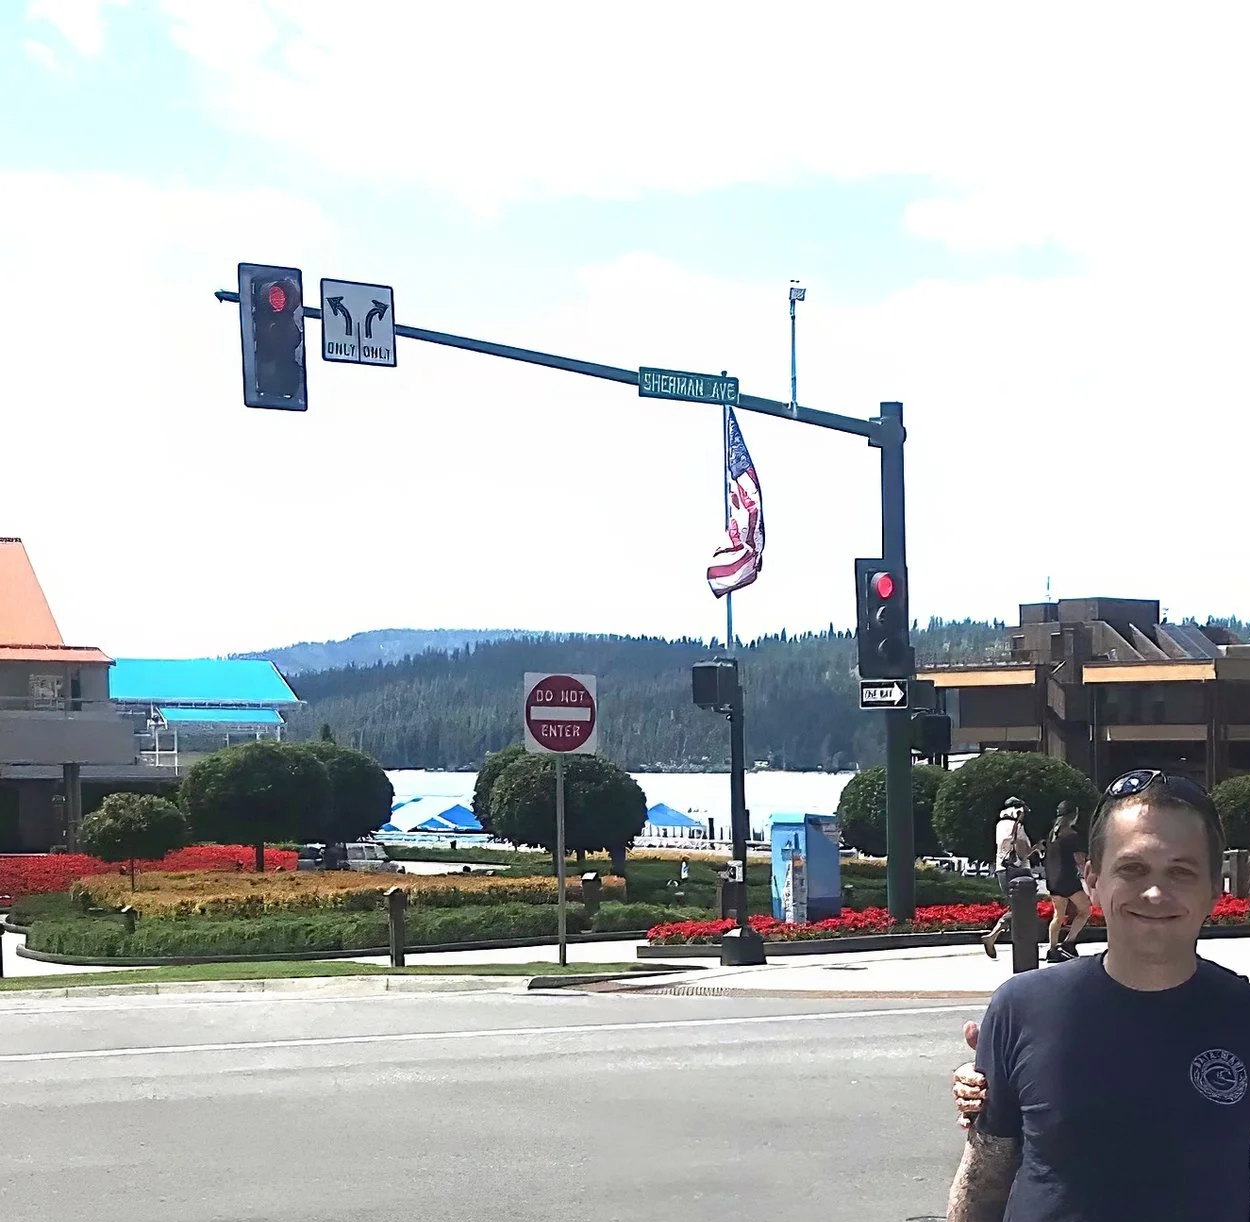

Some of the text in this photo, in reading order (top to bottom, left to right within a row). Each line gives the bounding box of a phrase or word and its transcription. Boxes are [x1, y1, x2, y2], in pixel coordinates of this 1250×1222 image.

[327, 341, 356, 357] ONLY
[363, 345, 391, 361] ONLY
[643, 372, 737, 401] SHERMAN AVE
[536, 689, 586, 703] DO NOT
[541, 724, 581, 737] ENTER
